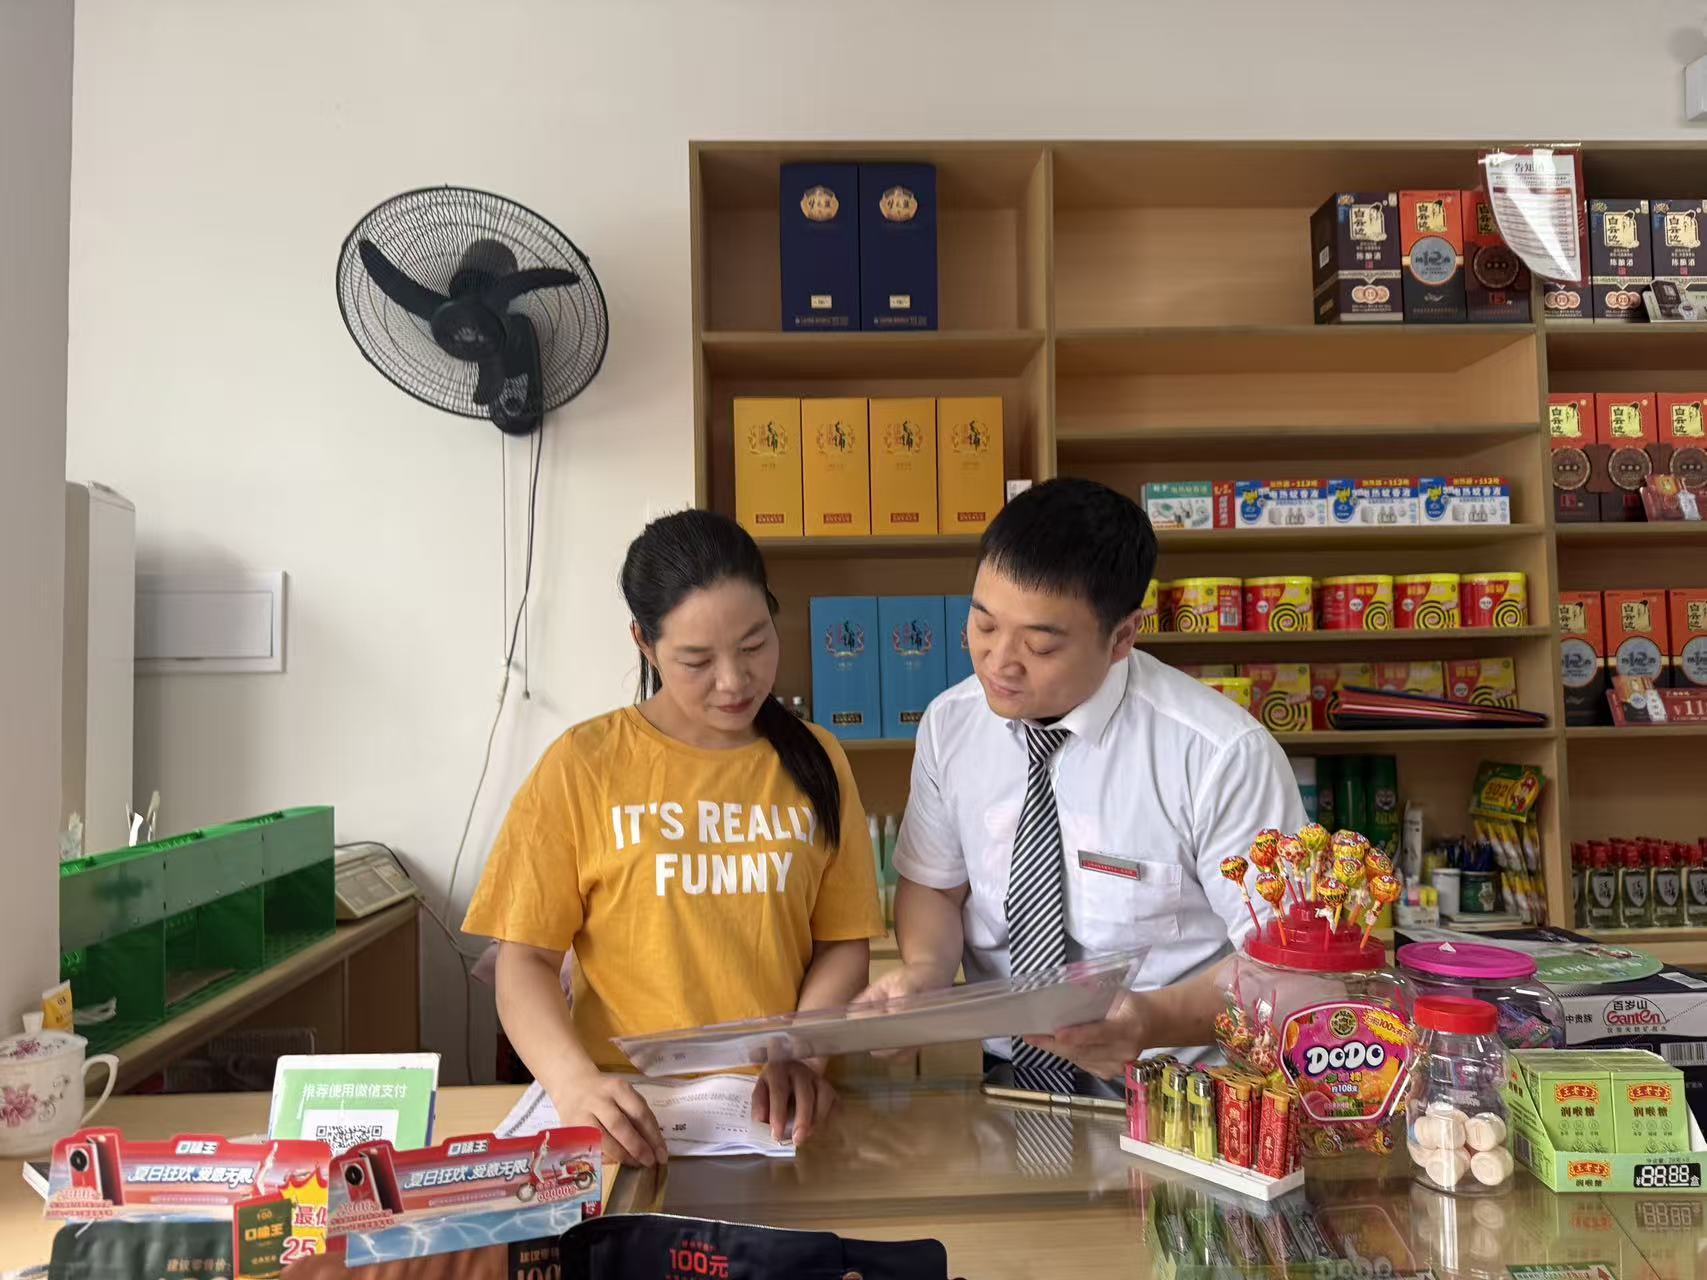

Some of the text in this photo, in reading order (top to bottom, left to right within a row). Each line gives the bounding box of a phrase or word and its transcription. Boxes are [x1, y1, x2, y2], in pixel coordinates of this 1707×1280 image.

[611, 800, 818, 850] IT'S REALLY
[656, 851, 793, 896] FUNNY
[1613, 1000, 1648, 1011] 百岁山
[303, 1082, 408, 1101] 推荐使用微信支付
[1561, 1106, 1595, 1117] 润喉糖
[1634, 1106, 1668, 1117] 润喉糖
[669, 1248, 729, 1278] 100元
